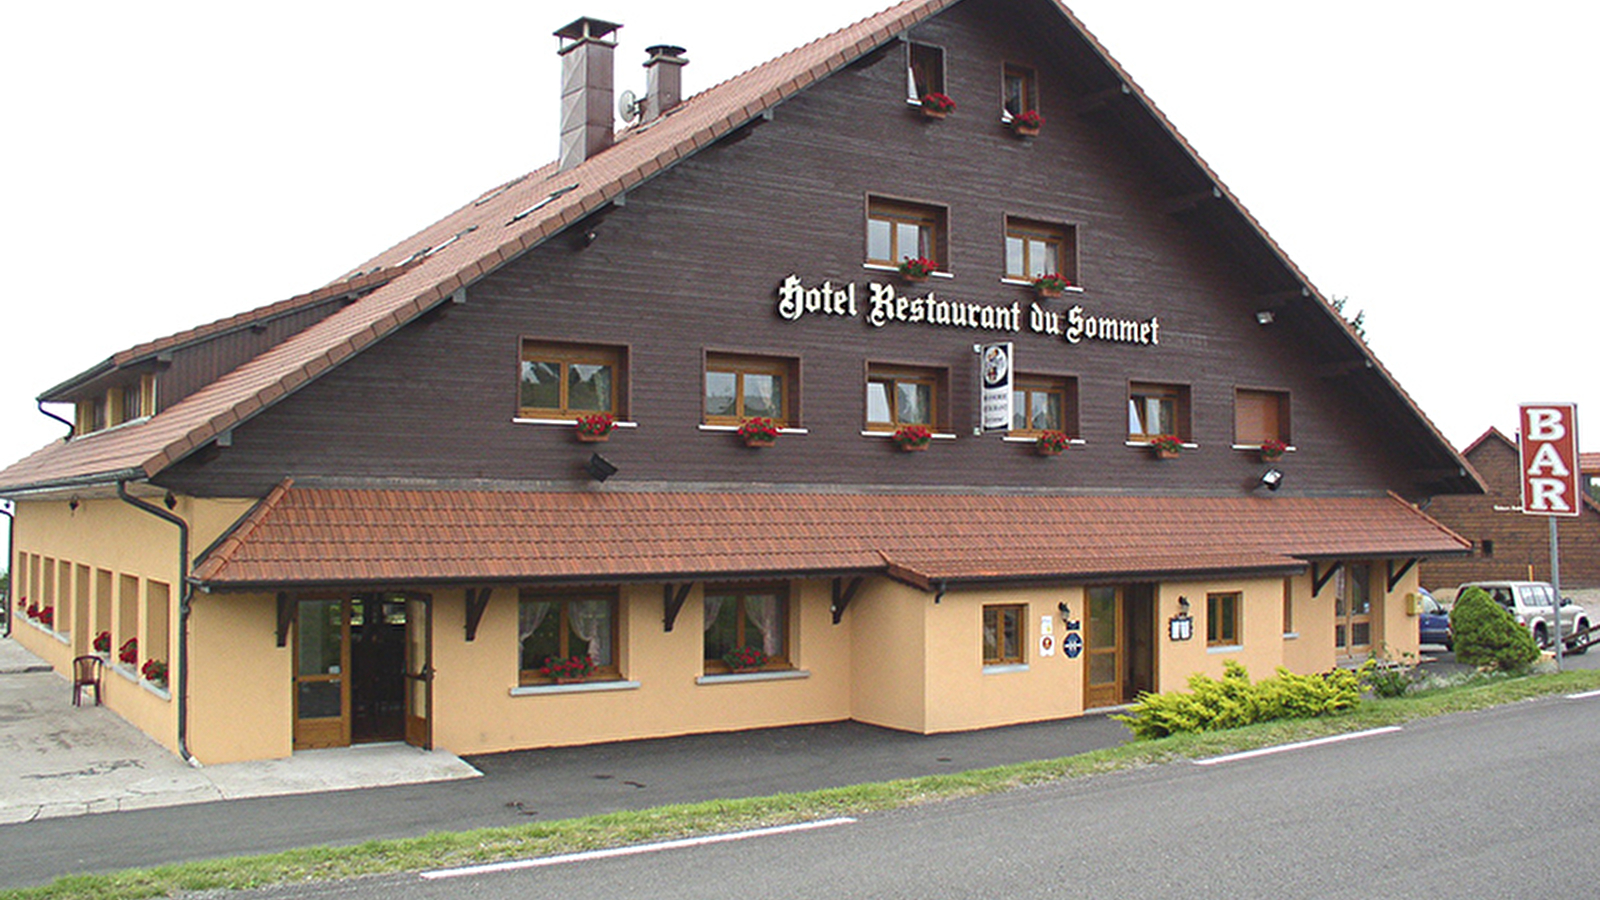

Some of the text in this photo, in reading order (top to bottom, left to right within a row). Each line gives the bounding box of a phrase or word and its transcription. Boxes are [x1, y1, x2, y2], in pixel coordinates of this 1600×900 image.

[778, 274, 1160, 345] Hotel Restaurant du Sommet
[1526, 408, 1570, 511] BAR
